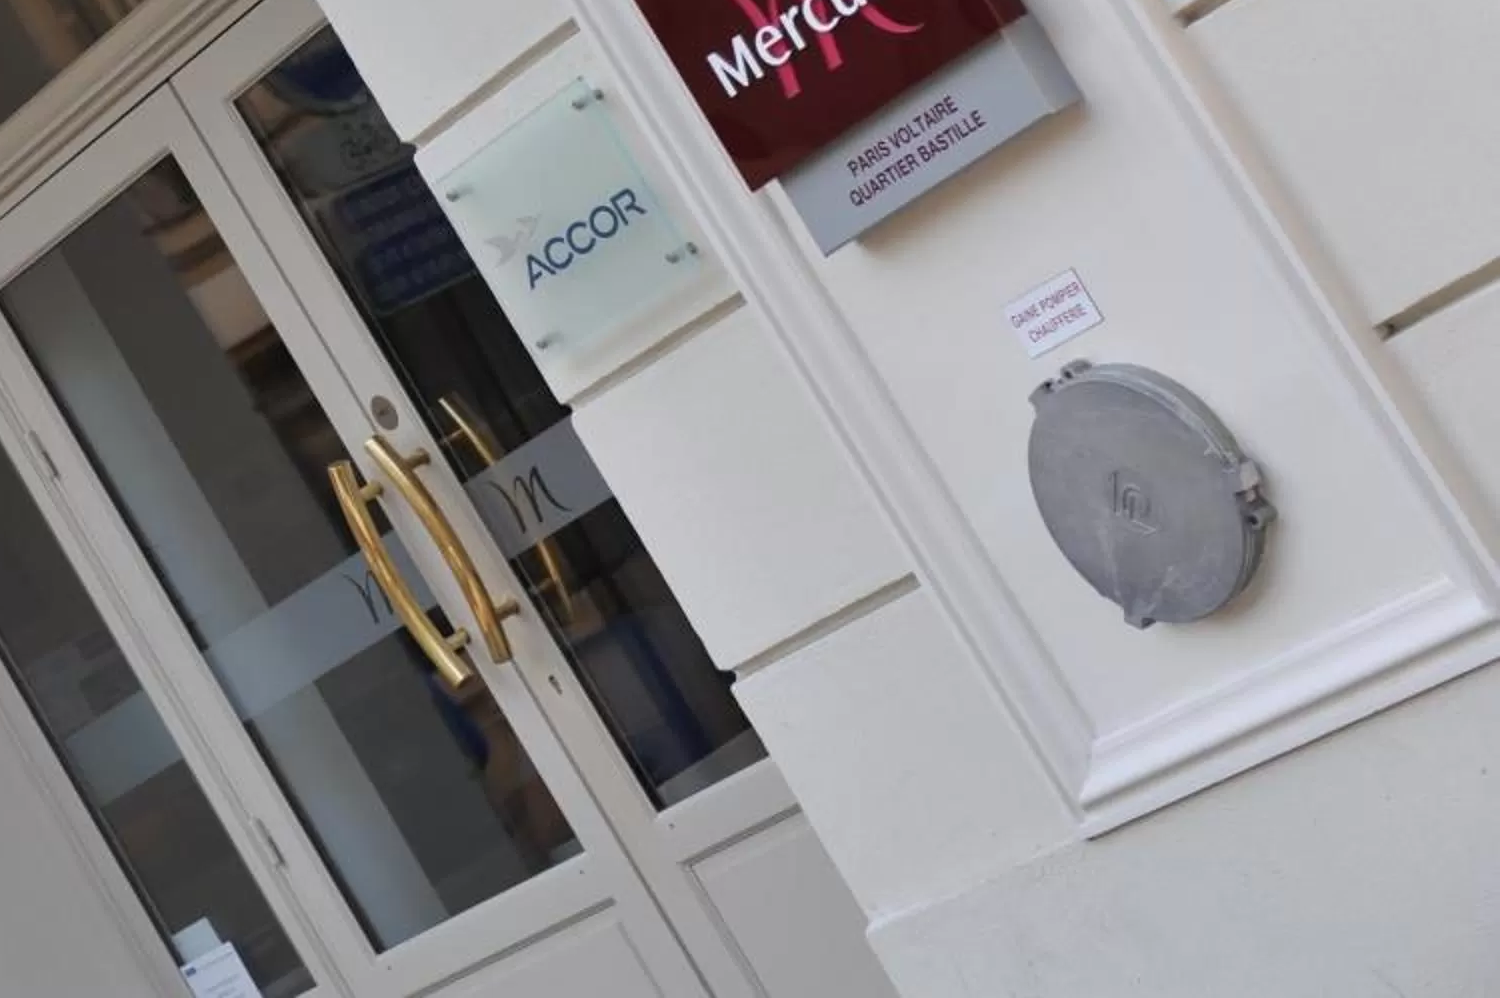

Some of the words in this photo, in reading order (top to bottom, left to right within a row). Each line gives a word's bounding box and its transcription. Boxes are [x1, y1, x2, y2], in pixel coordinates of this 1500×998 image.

[847, 141, 891, 177] PARIS
[888, 95, 958, 149] VOLTAIRE
[849, 153, 920, 206] QUARTIER
[917, 109, 986, 162] BASTILLE
[524, 187, 648, 290] ACCOR
